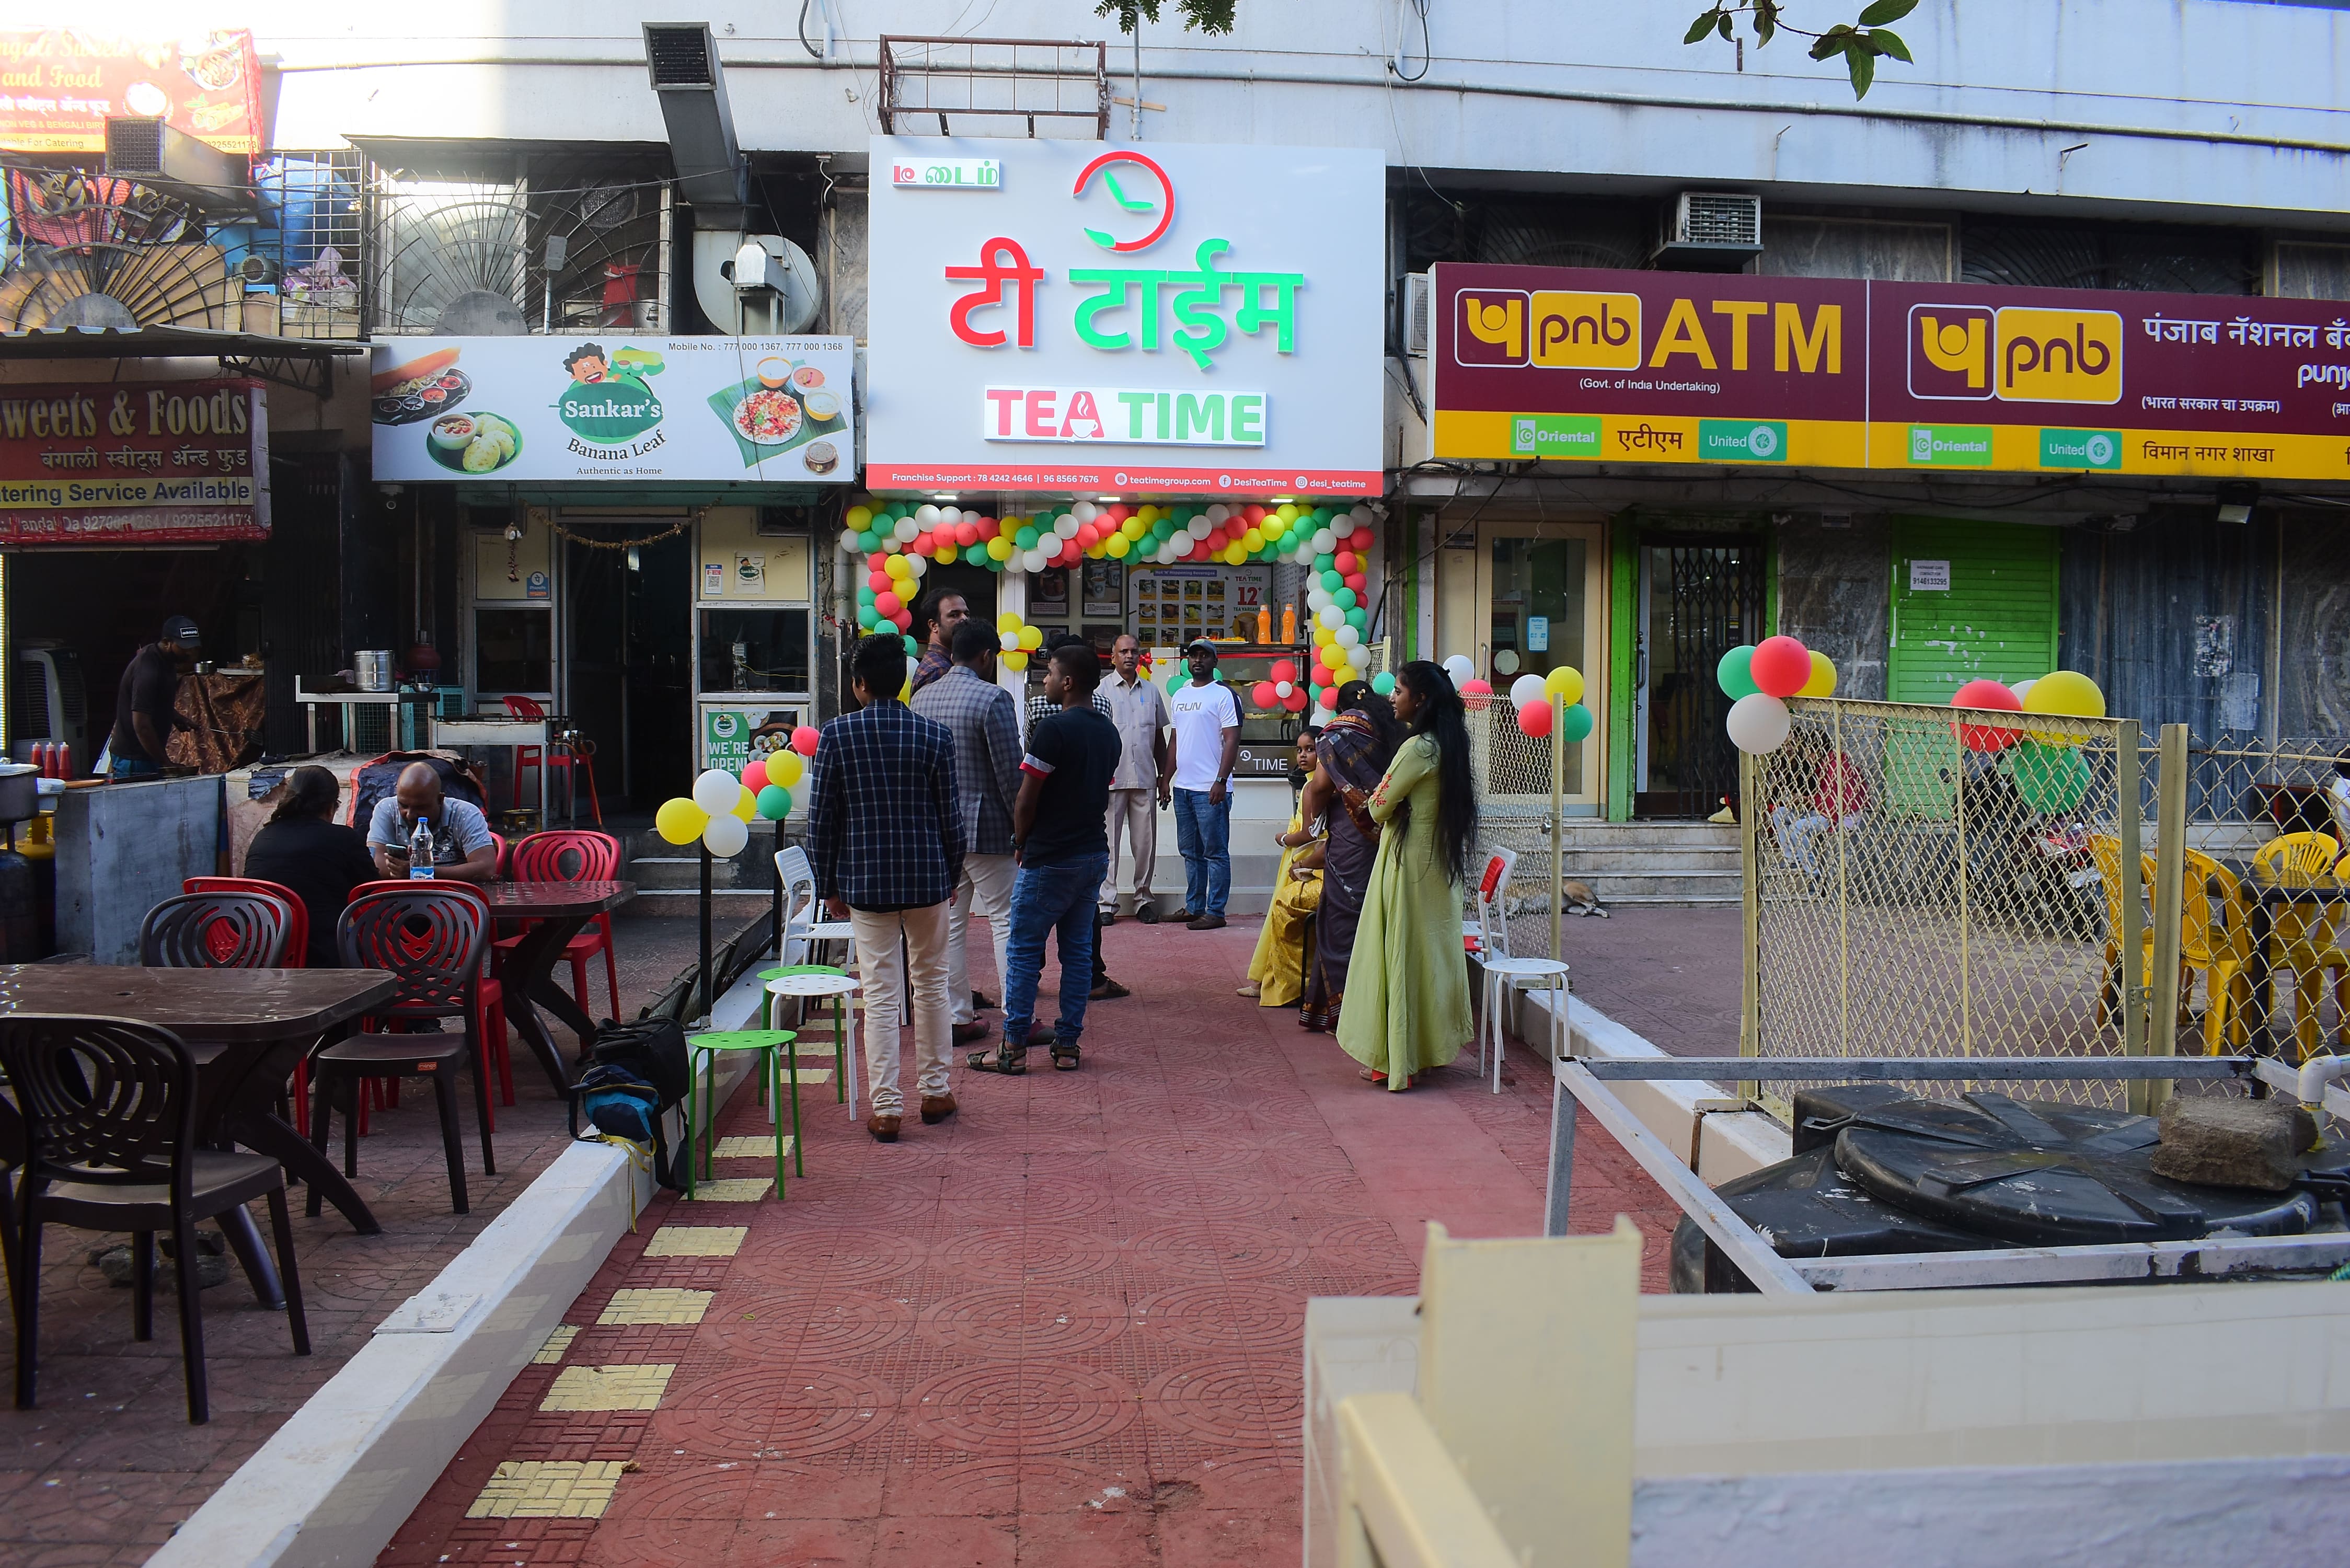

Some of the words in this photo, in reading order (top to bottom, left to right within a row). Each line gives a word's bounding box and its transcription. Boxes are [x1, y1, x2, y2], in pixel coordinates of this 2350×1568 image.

[3, 65, 43, 87] and
[50, 65, 104, 87] Food
[45, 139, 84, 149] Catering
[926, 160, 998, 185] டைம்
[945, 237, 1044, 350] टी
[1069, 238, 1304, 372] टाईम
[1539, 303, 1631, 358] pnb
[1648, 298, 1842, 374] ATM
[2142, 312, 2221, 344] पंजाब
[2226, 316, 2319, 349] नॅशनल
[761, 343, 784, 352] 1367,
[2006, 322, 2111, 388] pnb
[1579, 378, 1611, 390] (Govt.
[1614, 379, 1625, 390] of
[1628, 379, 1652, 390] India
[1655, 381, 1721, 394] Undertaking)
[2297, 364, 2350, 391] punj
[0, 392, 97, 439] weets
[109, 390, 136, 436] &
[147, 388, 247, 435] Foods
[565, 398, 662, 418] Sankar's
[2141, 396, 2177, 410] (भारत
[2179, 398, 2219, 411] सरकार
[2221, 399, 2237, 411] चा
[2239, 400, 2280, 414] उपक्रम)
[986, 389, 1104, 439] TEA
[1118, 392, 1263, 443] TIME
[566, 437, 629, 460] Banana
[630, 428, 667, 457] Leaf
[1537, 430, 1595, 443] Oriental
[1617, 423, 1684, 453] एटीएम
[1709, 434, 1747, 447] United
[1933, 440, 1987, 452] Oriental
[2049, 443, 2086, 456] United
[2142, 440, 2190, 460] विमान
[2194, 446, 2228, 462] नगर
[2232, 447, 2275, 463] शाखा
[40, 446, 99, 468] बंगाली
[105, 445, 163, 474] स्वीट्स
[215, 449, 247, 472] फुड
[892, 473, 934, 482] Franchise
[936, 474, 971, 483] Support
[1012, 474, 1033, 482] 4646
[1079, 475, 1099, 483] 7676
[1130, 475, 1211, 486] teatimegroup.com
[1234, 478, 1287, 487] DesiTeaTime
[1309, 479, 1366, 489] desi_teatime
[0, 485, 62, 506] tering
[69, 483, 147, 501] Service
[153, 481, 250, 499] Available
[172, 513, 252, 527] 9225521173
[1913, 577, 1948, 585] 9146133295
[1175, 701, 1202, 711] RUN
[708, 741, 749, 755] WE'RE
[1252, 758, 1288, 771] TIME
